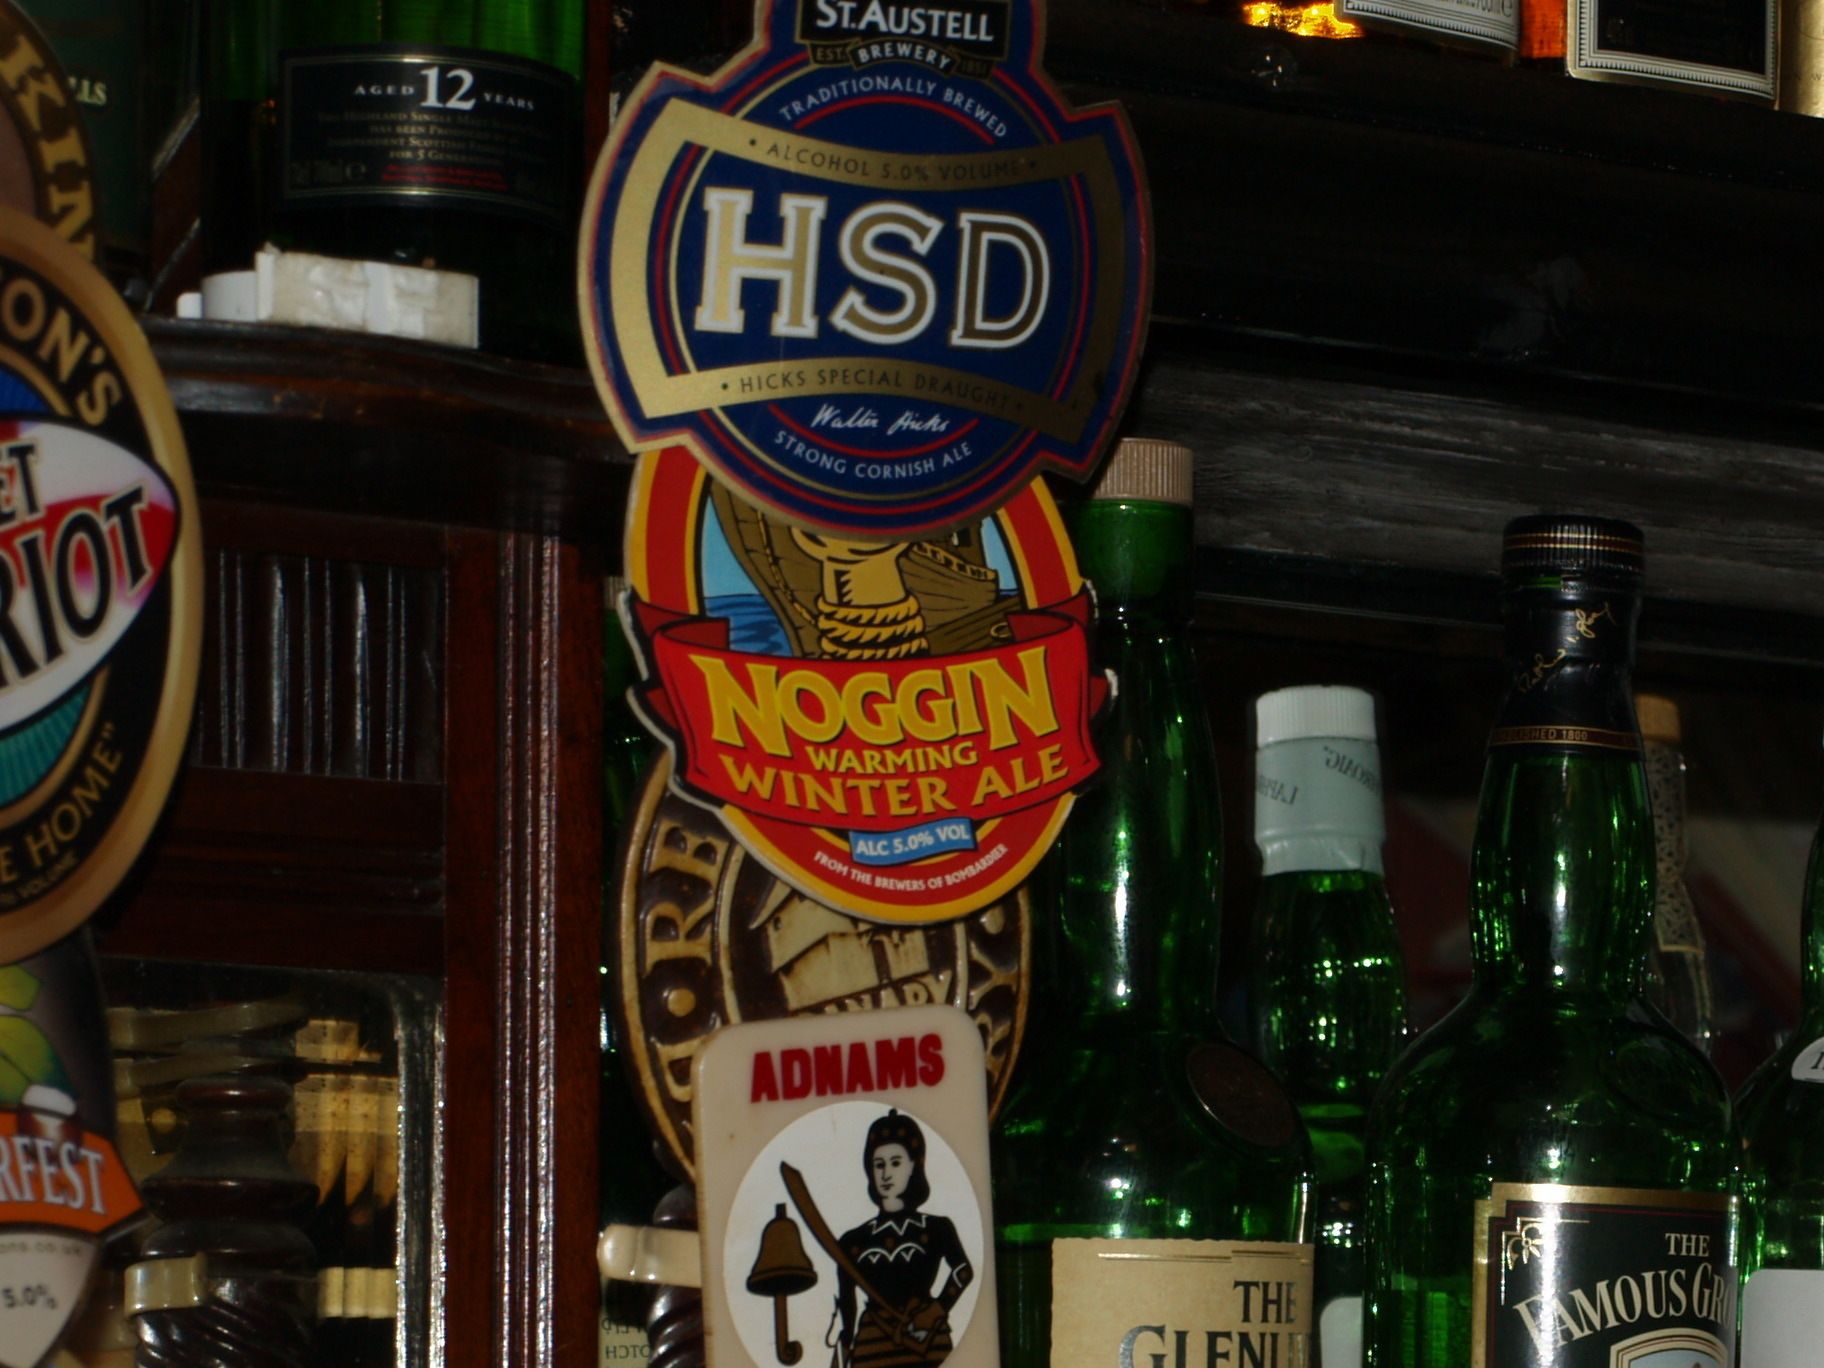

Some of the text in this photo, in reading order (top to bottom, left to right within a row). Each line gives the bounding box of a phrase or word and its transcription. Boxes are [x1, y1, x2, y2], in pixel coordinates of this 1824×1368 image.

[858, 42, 950, 70] BREWERY
[353, 66, 536, 111] AGED 12 YEARS
[779, 75, 1007, 137] TRADITIONALLY BREWED
[768, 142, 1022, 180] ALCOHOL 5.0% VOLUME
[695, 187, 1050, 348] HSD
[741, 370, 1011, 410] HICKS SPECIAL DRAUGHT
[774, 429, 972, 479] STRONG CORNISH ALE
[689, 646, 1060, 758] NOGGIN
[718, 745, 1068, 816] WINTER ALE
[805, 740, 978, 775] WARMING
[857, 823, 971, 857] ALC 5.0% VOL
[814, 844, 1008, 892] FROM THE BREWERS OF BOMBARDIER
[750, 1034, 945, 1103] ADNAMS
[1666, 1232, 1710, 1258] THE
[1233, 1280, 1296, 1323] THE
[1513, 1269, 1685, 1355] FAMOUS
